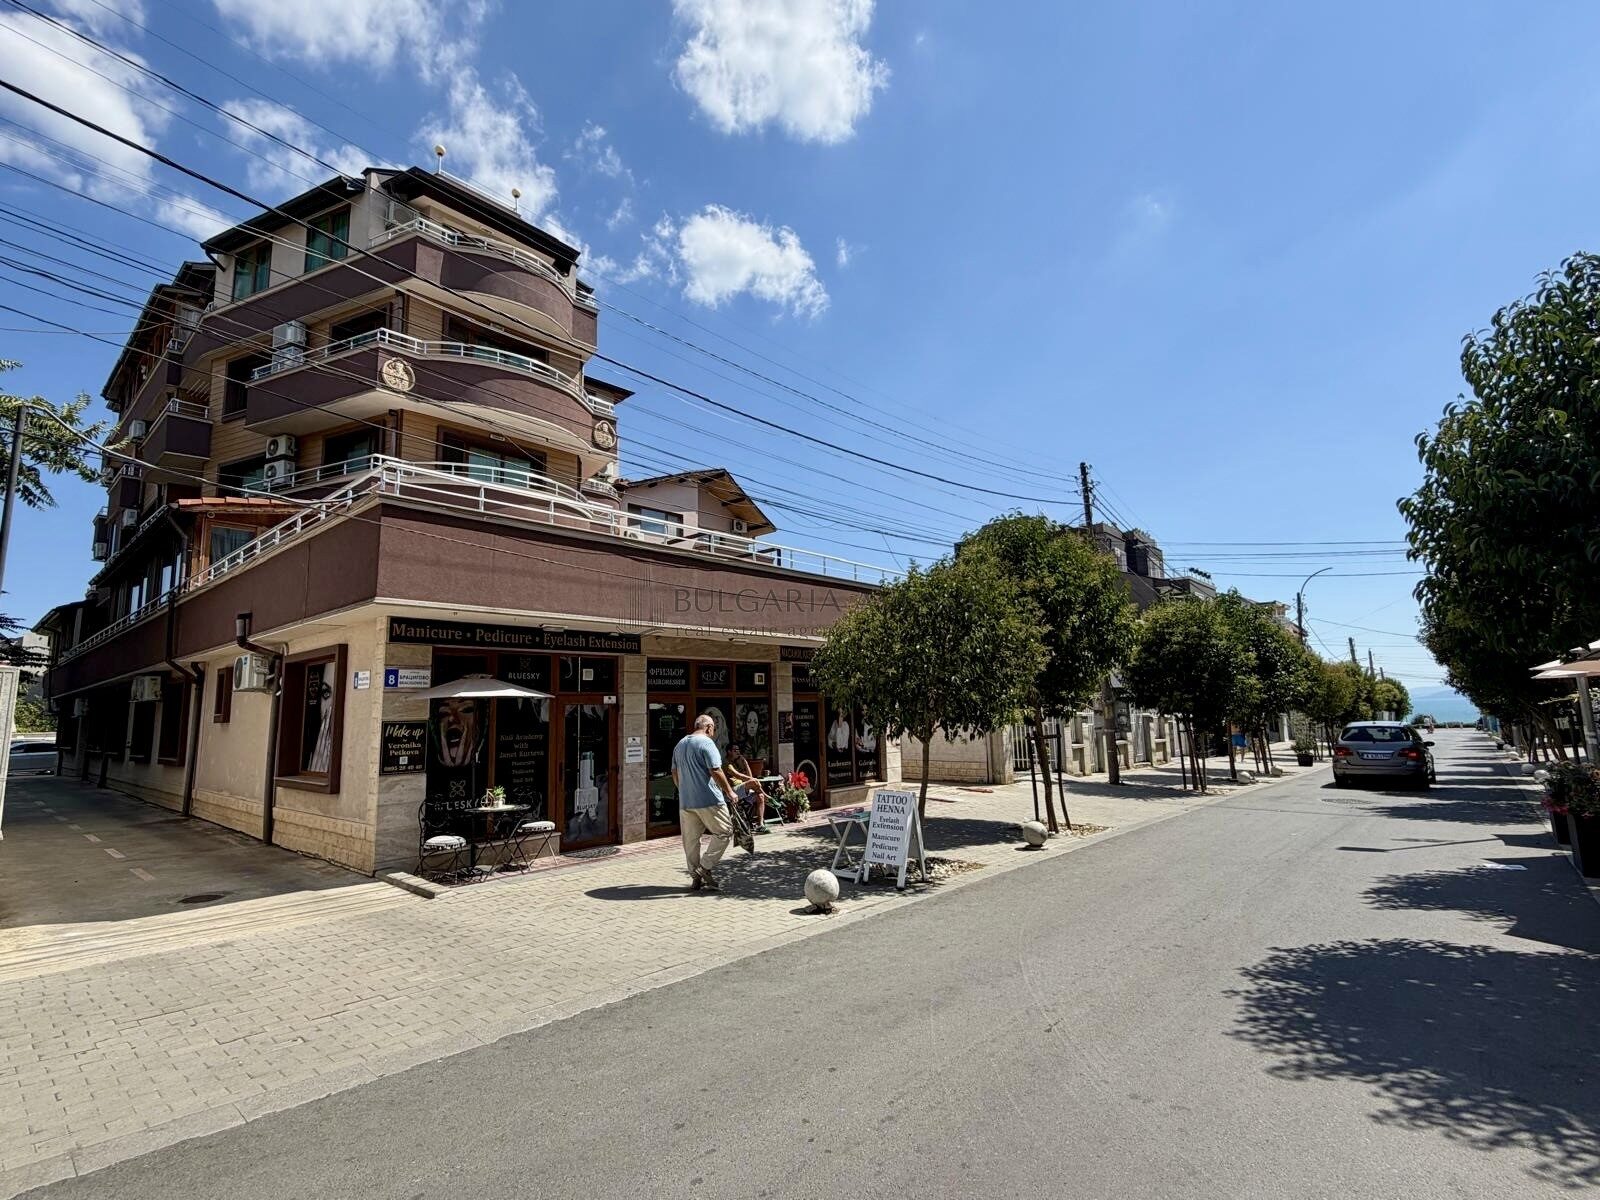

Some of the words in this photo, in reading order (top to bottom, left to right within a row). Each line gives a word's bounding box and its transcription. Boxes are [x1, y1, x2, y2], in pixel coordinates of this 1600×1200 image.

[392, 622, 463, 640] Manicure
[475, 628, 533, 645] Pedicure
[543, 631, 586, 648] Eyelash
[588, 635, 639, 650] Extension
[388, 674, 396, 685] 8
[508, 671, 540, 680] BLUESKY
[388, 741, 422, 749] Veronika
[876, 794, 908, 805] TATTOO
[876, 804, 905, 814] HENNA
[879, 816, 900, 825] Eyelash
[872, 822, 904, 831] Extension
[872, 833, 901, 842] Manicure
[871, 842, 898, 851] Pedicure
[872, 851, 885, 859] Nail
